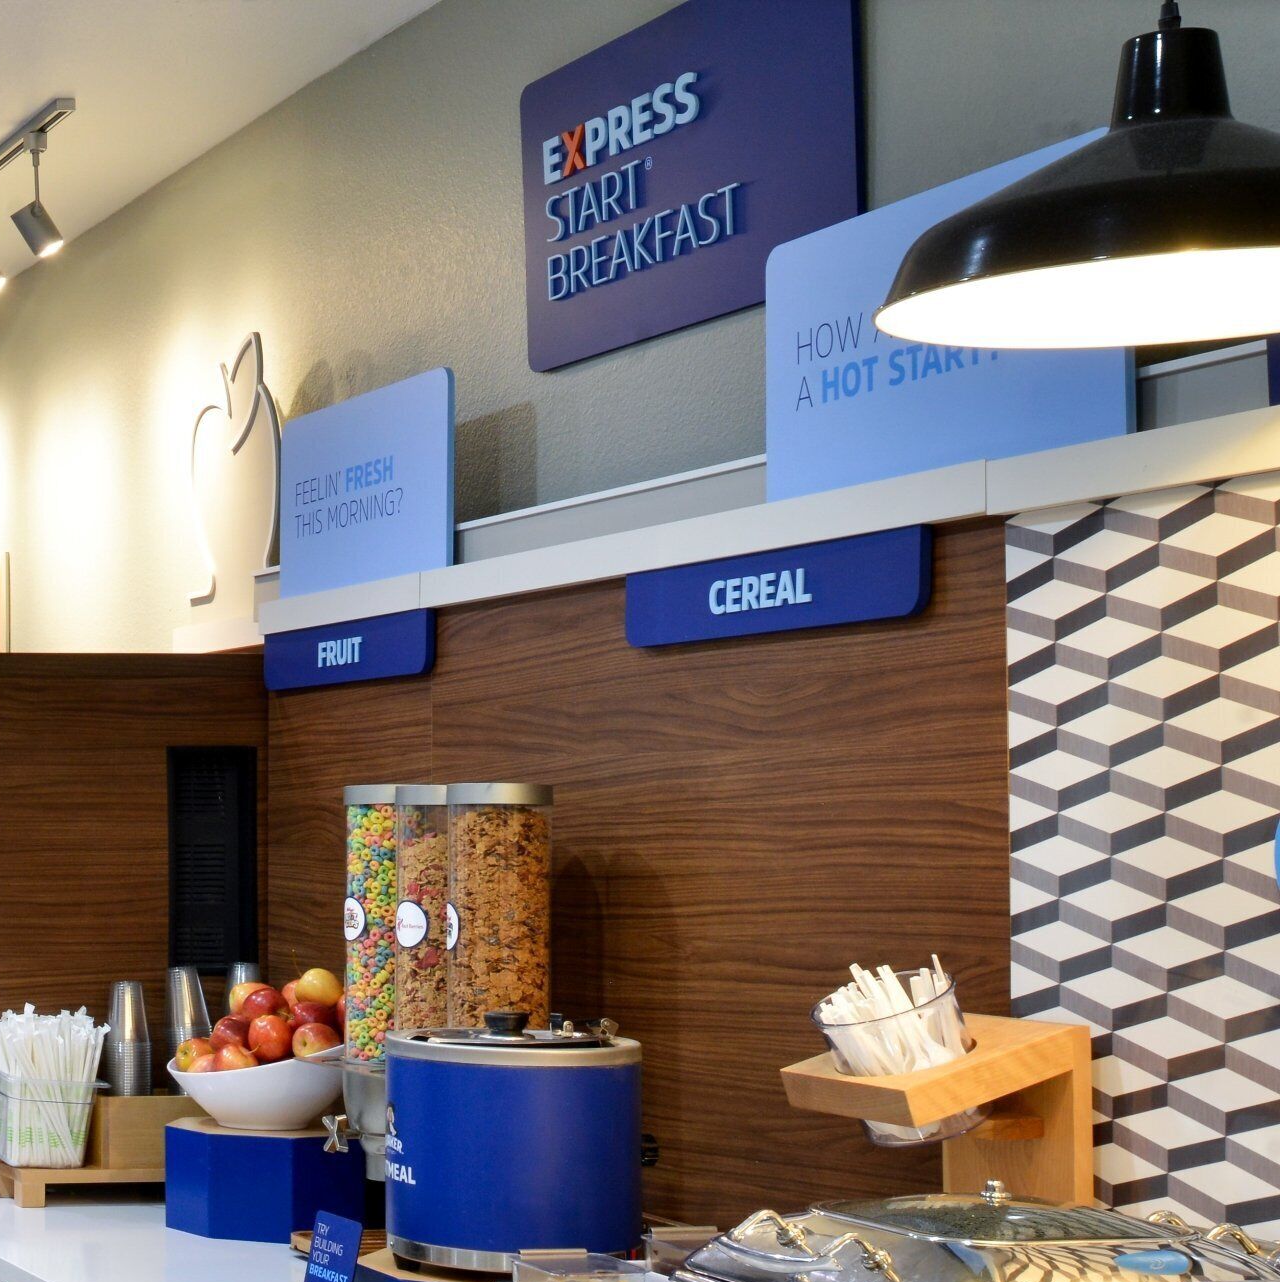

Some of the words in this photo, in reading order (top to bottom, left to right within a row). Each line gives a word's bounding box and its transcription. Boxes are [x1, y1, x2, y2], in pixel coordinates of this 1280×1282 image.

[542, 71, 700, 185] EXPRESS
[547, 182, 741, 301] BREAKFAST
[797, 312, 863, 365] HOW
[796, 376, 813, 412] A
[822, 355, 879, 404] HOT
[295, 470, 342, 508] FEELIN'
[345, 455, 394, 493] FRESH
[294, 508, 323, 539] THIS
[327, 487, 404, 531] MORNING?
[708, 568, 813, 615] CEREAL
[317, 636, 363, 668] FRUIT
[314, 1236, 344, 1257] BUILDING
[317, 1222, 330, 1237] TRY
[312, 1250, 330, 1266] YOUR
